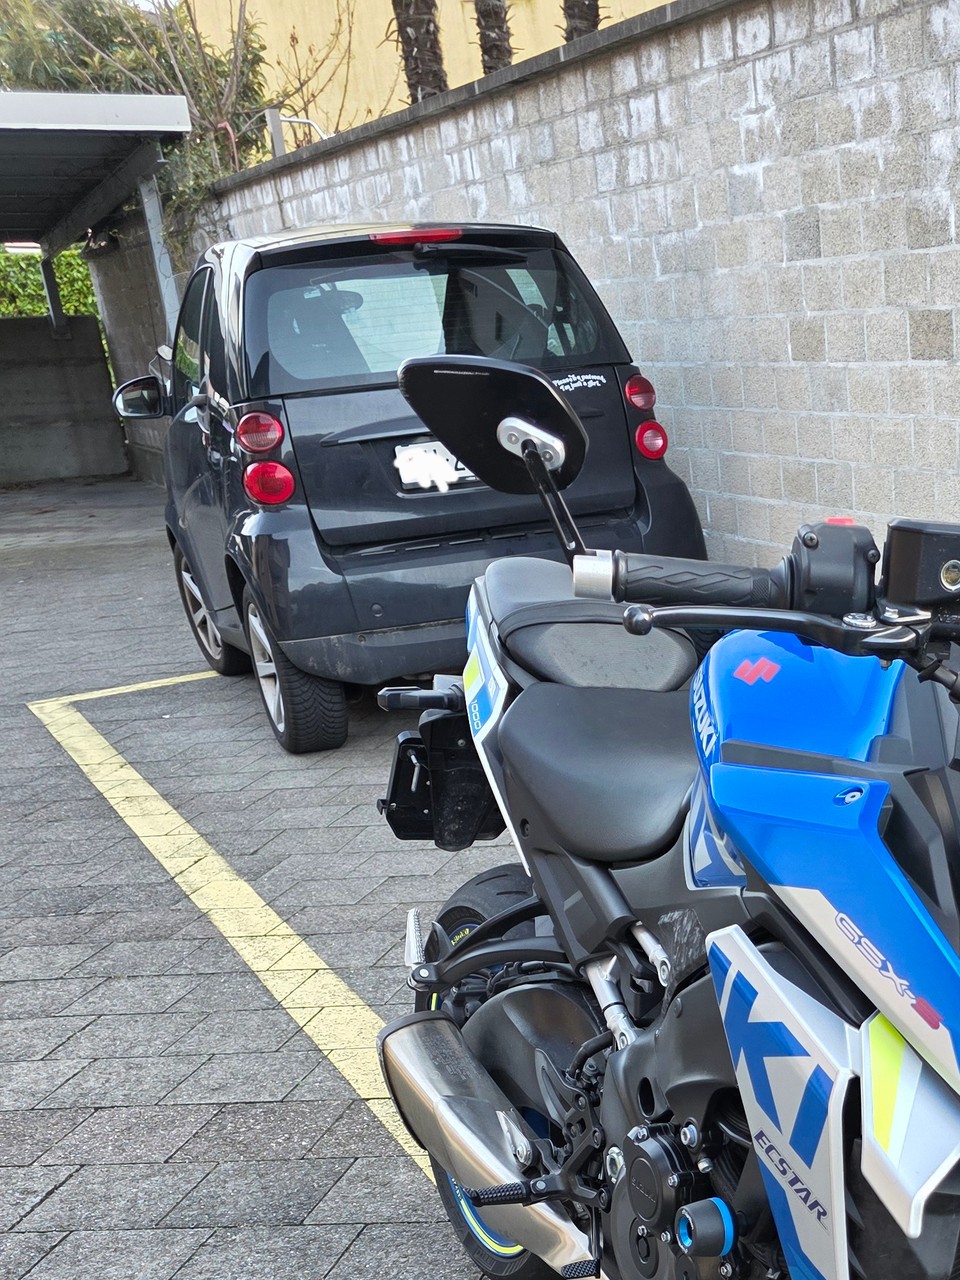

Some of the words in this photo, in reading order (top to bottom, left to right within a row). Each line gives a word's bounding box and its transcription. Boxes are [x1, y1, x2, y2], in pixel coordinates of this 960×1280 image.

[469, 699, 482, 730] 1000
[835, 912, 944, 1030] GSX-S
[708, 942, 835, 1170] KI
[753, 1129, 830, 1231] ECSTAR
